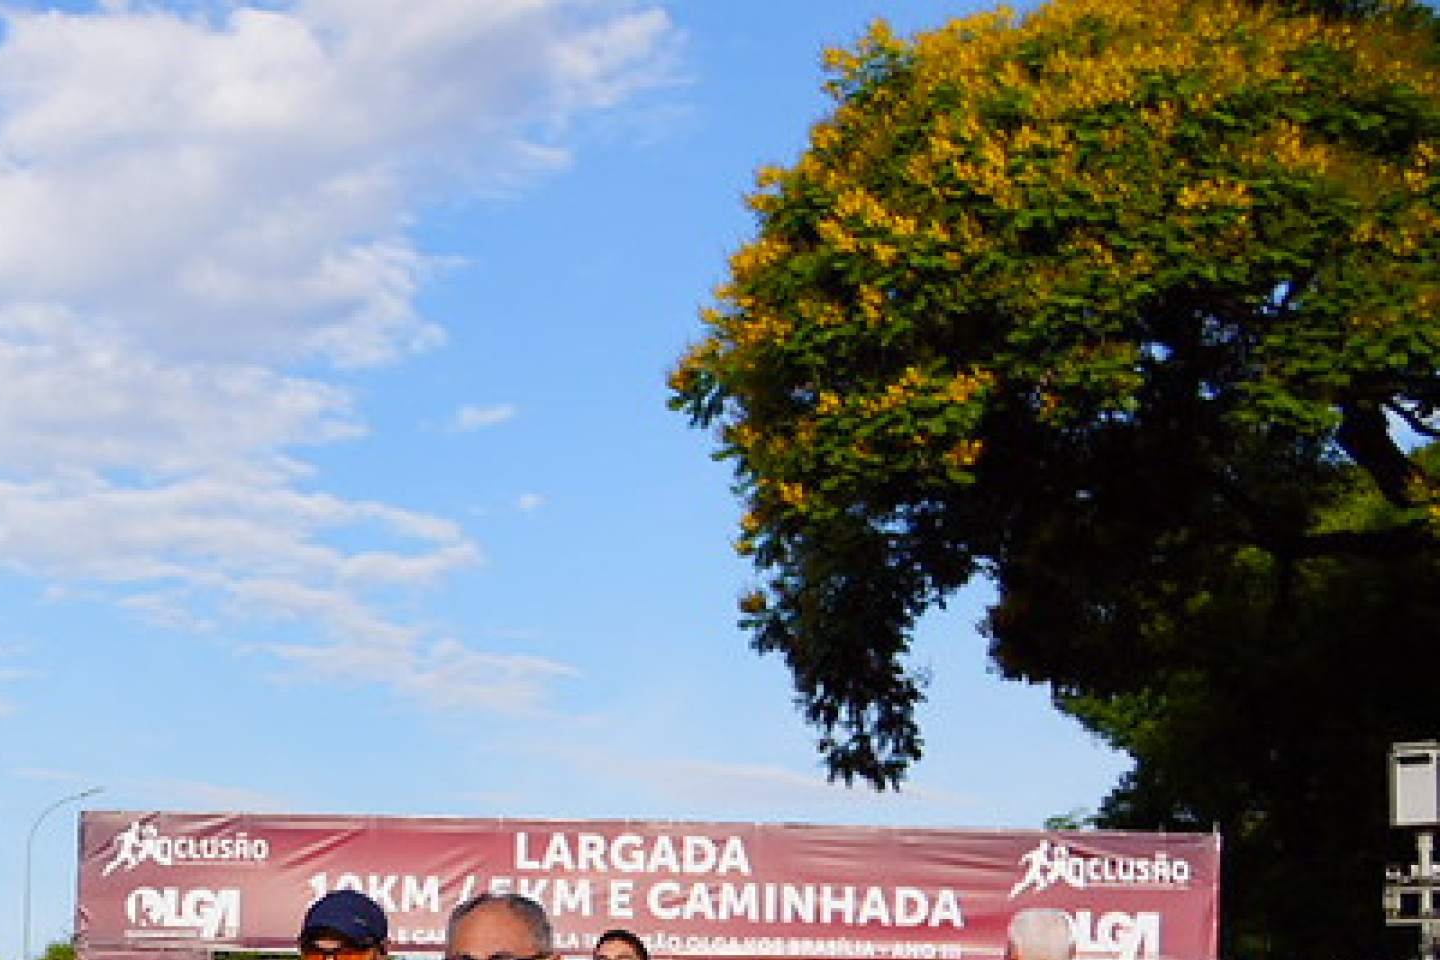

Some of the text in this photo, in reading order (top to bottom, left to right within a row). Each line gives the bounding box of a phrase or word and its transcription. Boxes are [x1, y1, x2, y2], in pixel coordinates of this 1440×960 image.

[516, 831, 752, 876] LARGADA
[126, 887, 242, 940] OLGA
[609, 880, 635, 919] E
[647, 882, 965, 929] CAMINHADA
